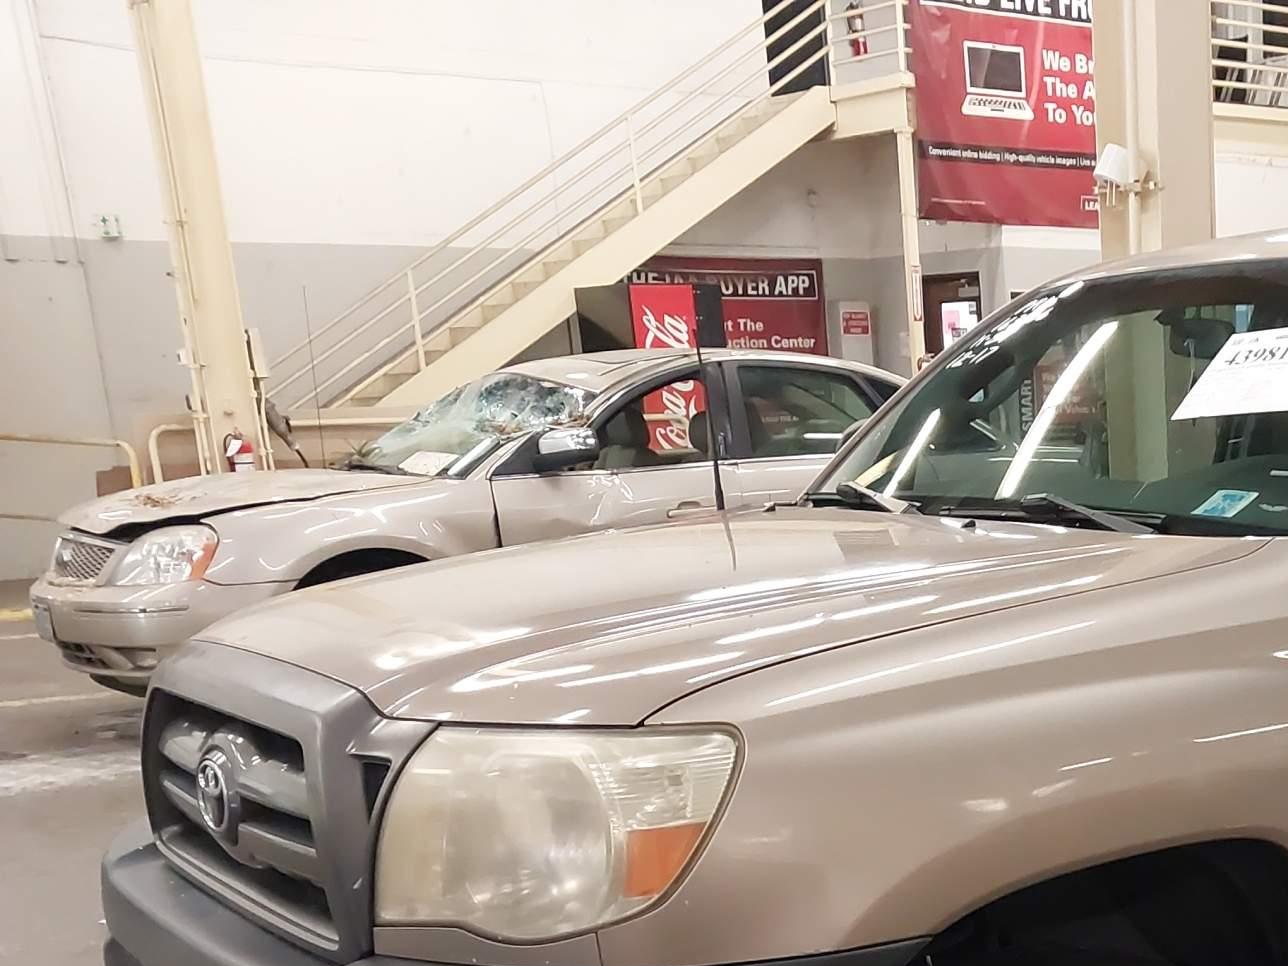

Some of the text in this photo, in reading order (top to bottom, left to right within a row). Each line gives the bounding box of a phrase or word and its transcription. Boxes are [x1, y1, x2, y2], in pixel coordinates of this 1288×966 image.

[1057, 0, 1093, 20] FR
[1042, 48, 1071, 72] We
[1043, 76, 1077, 98] The
[1043, 102, 1096, 126] To Yo
[774, 275, 809, 296] APP
[737, 317, 764, 332] The
[771, 334, 817, 349] Center
